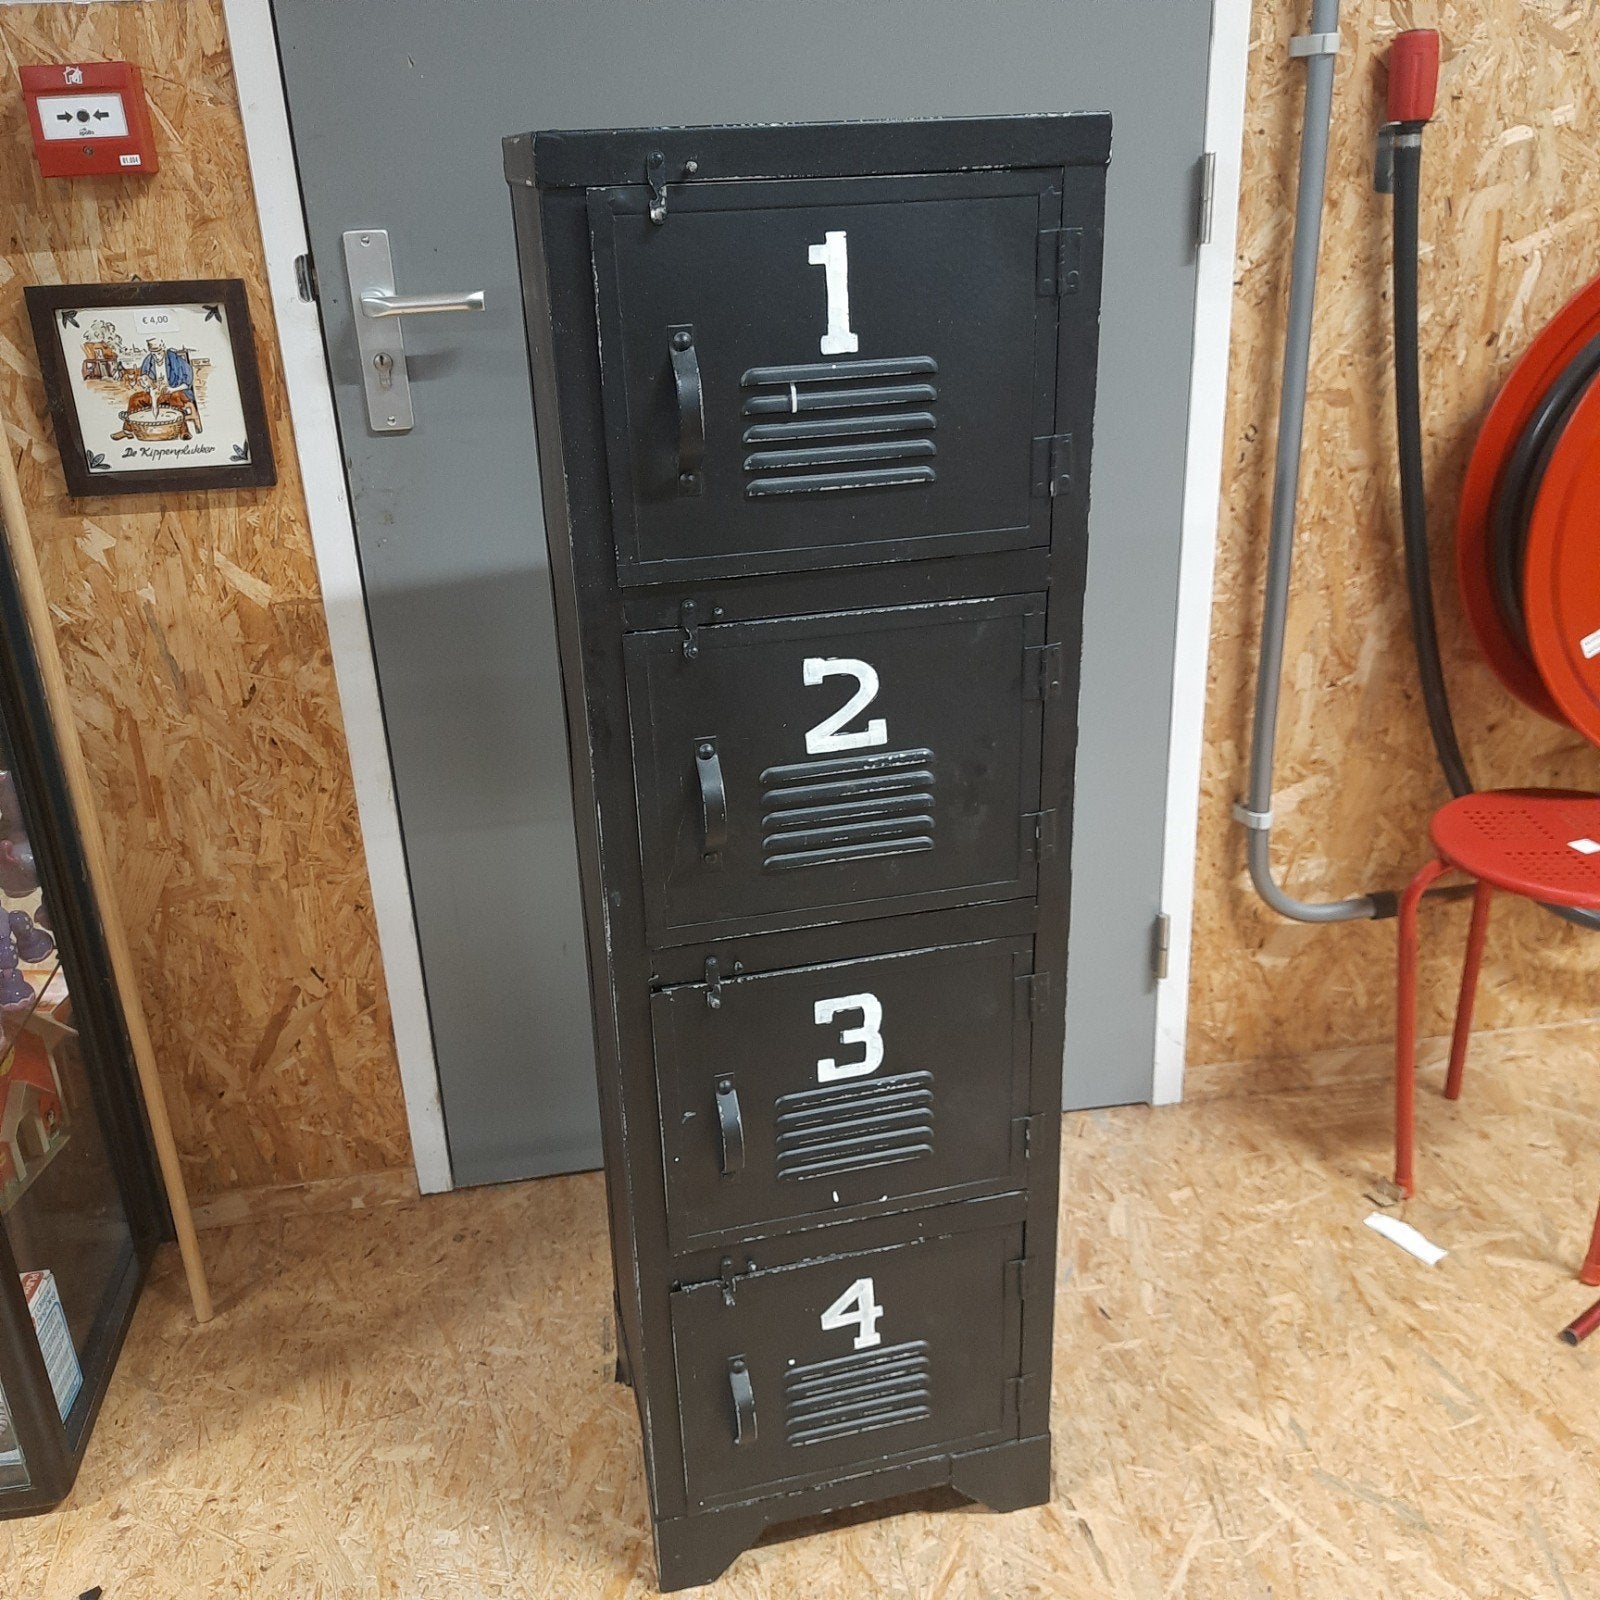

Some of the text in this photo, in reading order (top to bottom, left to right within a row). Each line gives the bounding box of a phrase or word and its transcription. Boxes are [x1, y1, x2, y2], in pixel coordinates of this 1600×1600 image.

[142, 315, 169, 325] € 4,00
[808, 230, 859, 355] 1
[121, 447, 138, 458] De
[802, 657, 888, 755] 2
[814, 992, 884, 1083] 3
[820, 1278, 884, 1350] 4
